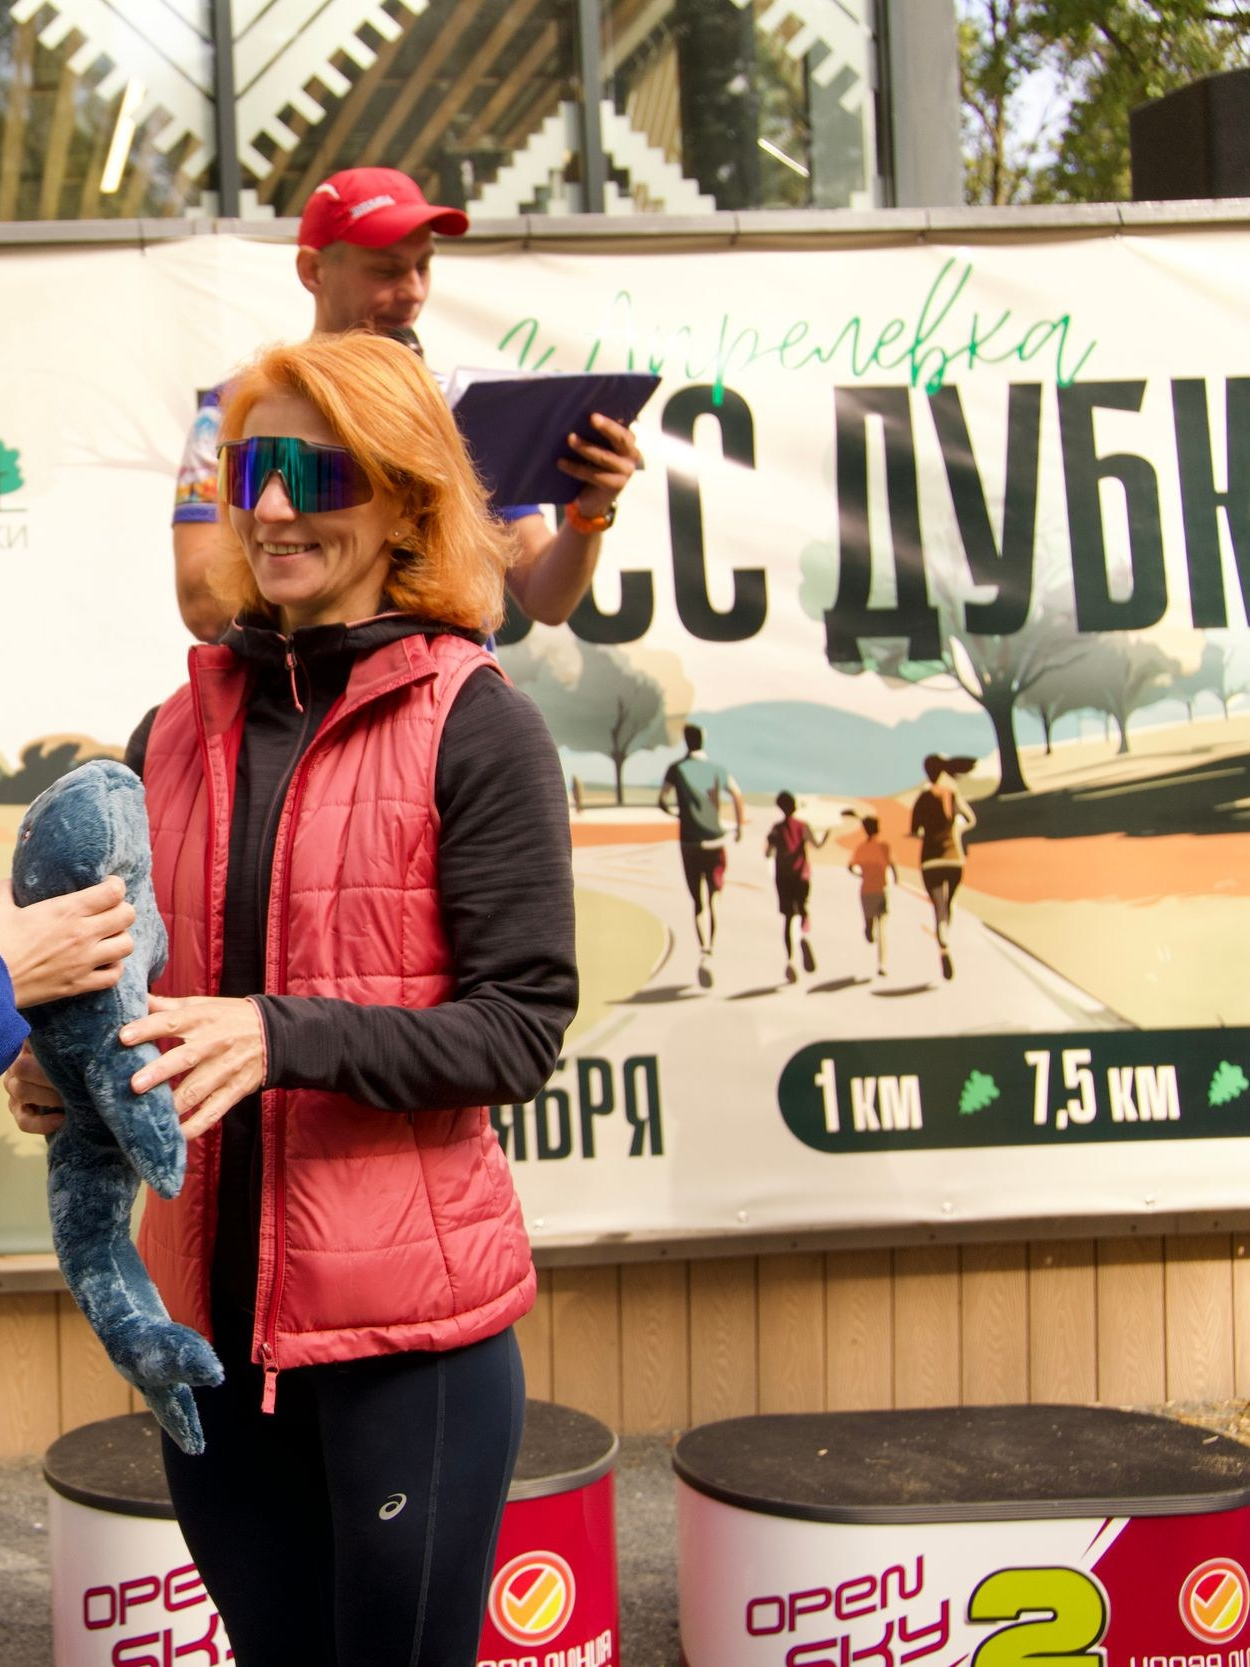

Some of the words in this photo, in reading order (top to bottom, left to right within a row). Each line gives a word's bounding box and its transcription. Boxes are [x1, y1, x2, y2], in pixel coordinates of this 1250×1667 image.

[814, 1058, 841, 1133] 1
[1024, 1048, 1098, 1131] 7,5
[111, 1610, 236, 1667] SK
[966, 1565, 1108, 1667] 2
